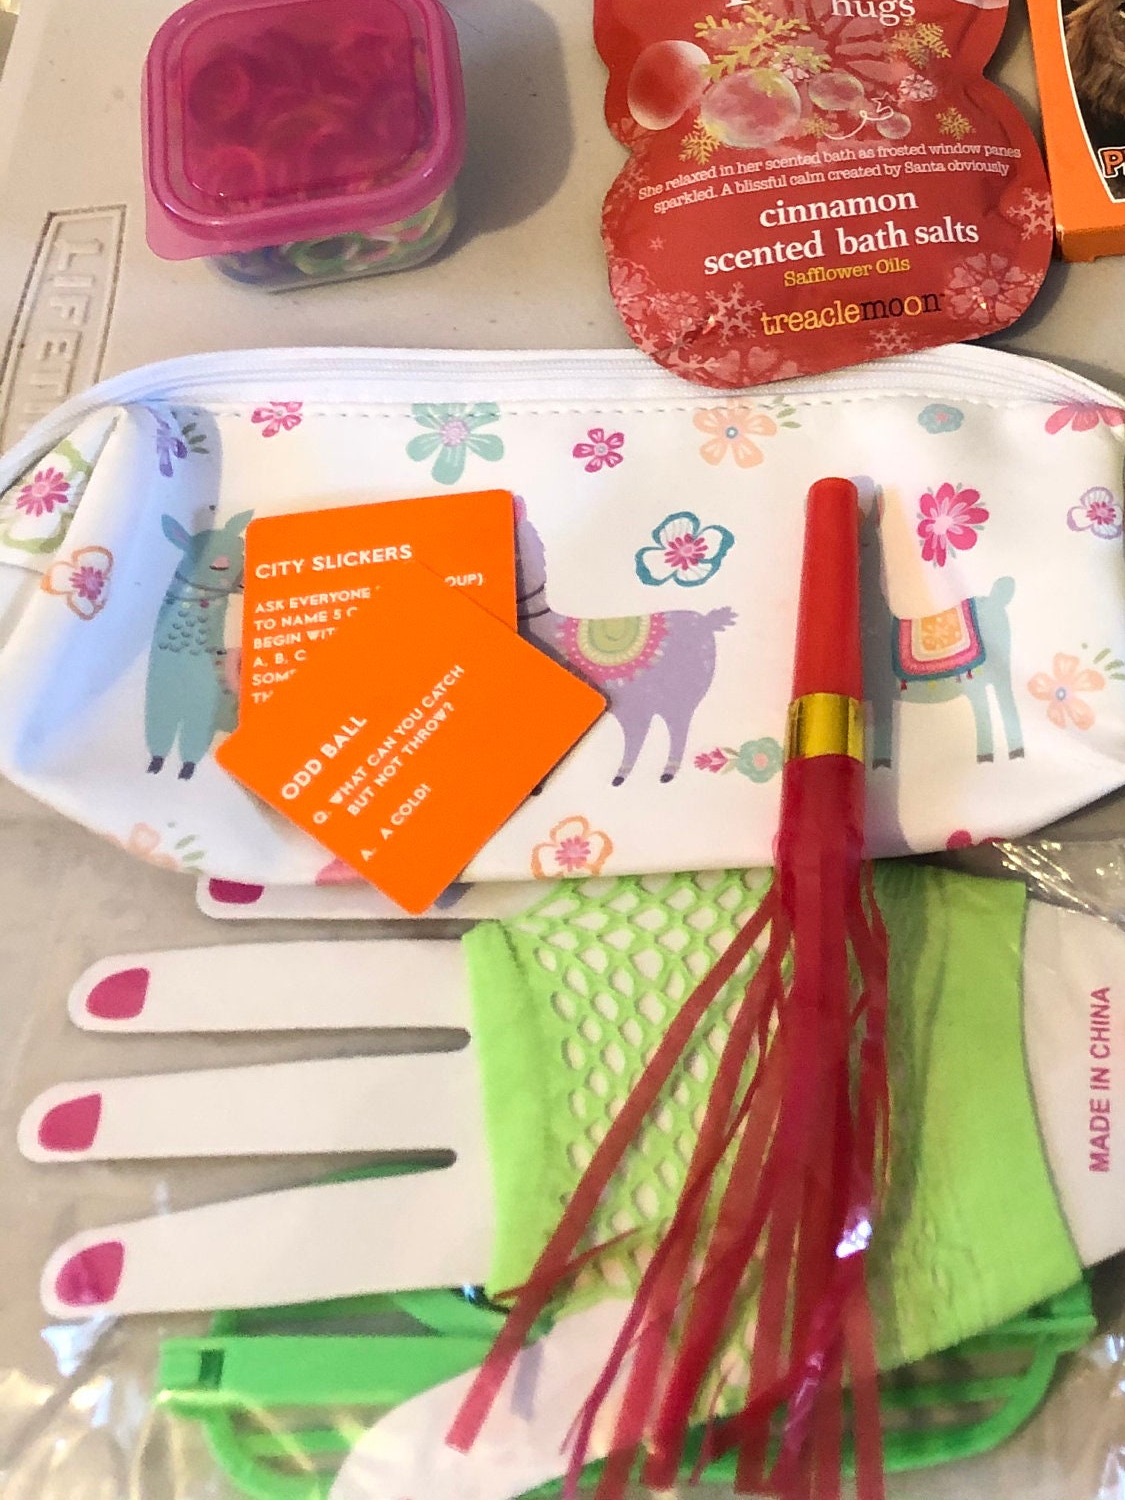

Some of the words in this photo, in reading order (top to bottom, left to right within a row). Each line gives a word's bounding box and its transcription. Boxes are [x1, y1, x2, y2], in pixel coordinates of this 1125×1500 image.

[638, 184, 664, 200] She
[665, 166, 718, 191] relaxed
[720, 165, 735, 177] in
[737, 161, 763, 174] her
[765, 152, 821, 170] scented
[823, 148, 856, 163] bath
[858, 149, 875, 159] as
[877, 144, 927, 157] frosted
[929, 143, 981, 155] window
[984, 145, 1022, 158] panes
[653, 186, 718, 214] sparkled.
[720, 183, 734, 197] A
[734, 174, 787, 194] blissful
[789, 171, 825, 186] calm
[827, 165, 881, 181] created
[883, 163, 902, 178] by
[904, 161, 945, 174] Santa
[947, 160, 1010, 177] obviously
[759, 191, 919, 228] cinnamon
[703, 230, 825, 275] scented
[835, 220, 909, 255] bath
[914, 216, 980, 245] salts
[784, 264, 873, 287] Safflower
[876, 257, 911, 274] Oils
[760, 293, 941, 336] treaclemoon
[255, 559, 304, 579] CITY
[312, 544, 413, 571] SLICKERS
[254, 620, 276, 631] TO
[282, 611, 327, 627] NAME
[333, 610, 341, 620] 5
[255, 600, 285, 613] ASK
[289, 588, 370, 609] EVERYONE
[253, 633, 301, 649] BEGIN
[282, 759, 322, 799] ODD
[320, 716, 368, 759] BALL
[329, 766, 368, 804] WHAT
[367, 736, 397, 766] CAN
[394, 708, 423, 736] YOU
[422, 665, 465, 707] CATCH
[347, 786, 375, 816] BUT
[374, 756, 403, 787] NOT
[401, 701, 454, 755] THROW?
[380, 828, 394, 840] A
[391, 783, 432, 825] COLD!
[1089, 987, 1110, 1059] CHINA
[1090, 1067, 1110, 1090] IN
[1089, 1099, 1110, 1172] MADE
